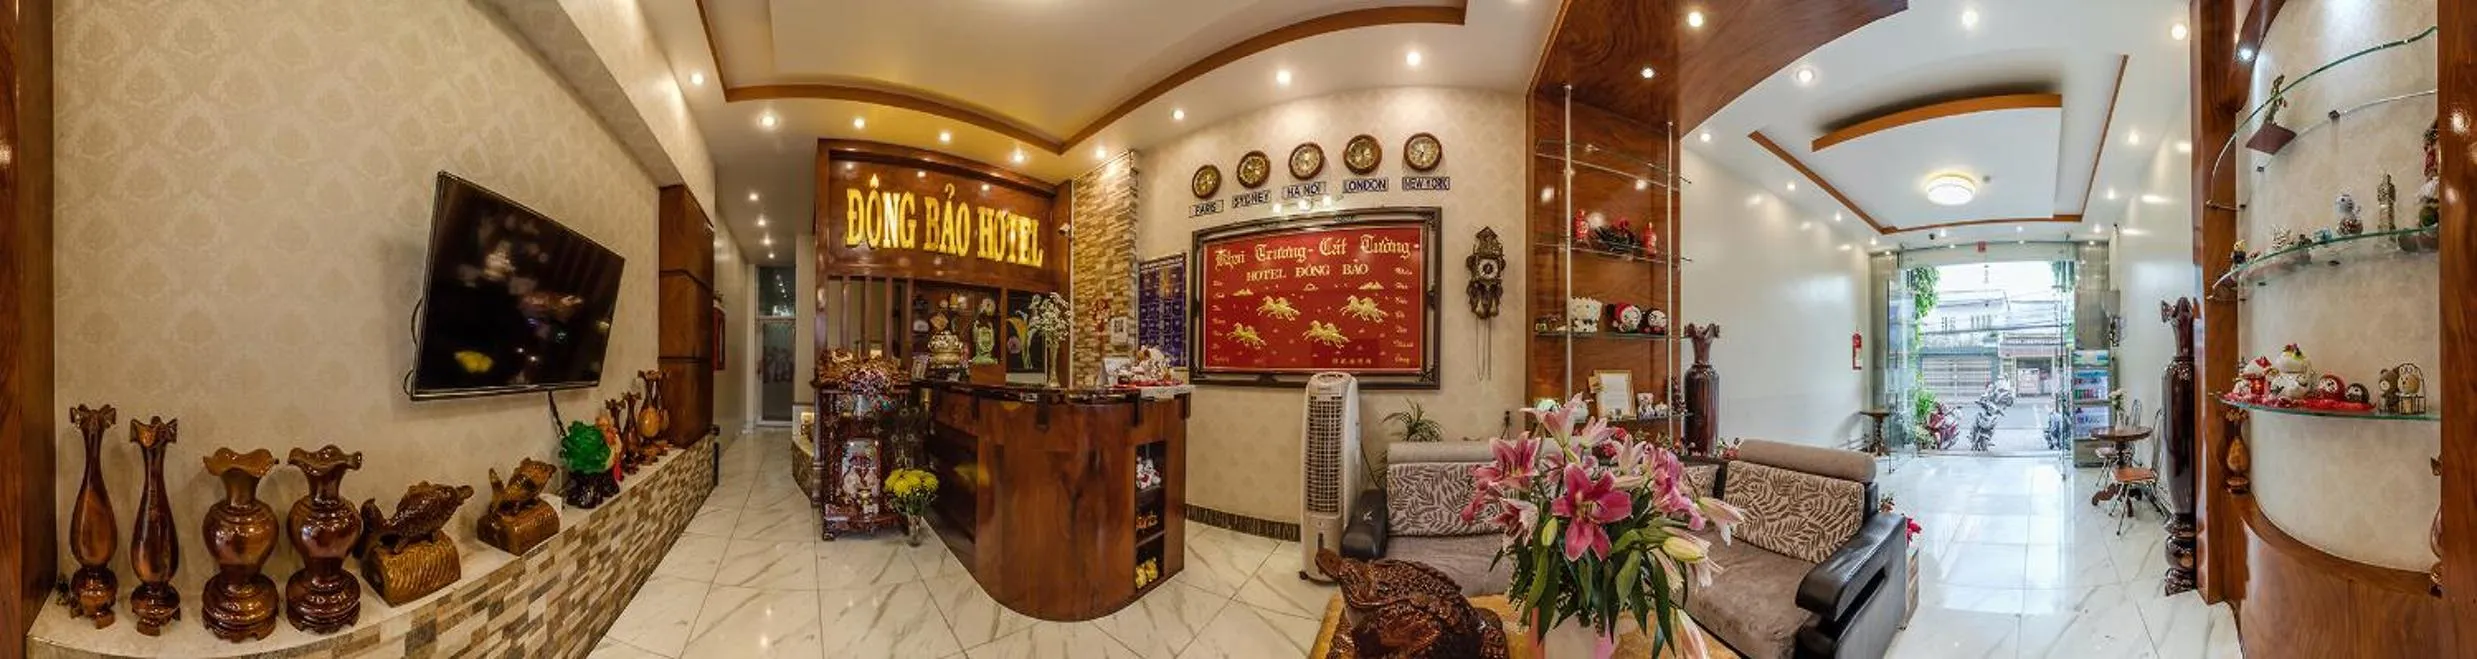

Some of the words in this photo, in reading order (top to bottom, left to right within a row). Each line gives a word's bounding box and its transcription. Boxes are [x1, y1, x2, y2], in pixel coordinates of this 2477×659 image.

[1344, 179, 1386, 192] LONDON
[1233, 192, 1269, 208] SYDNEY
[846, 173, 918, 249] ĐÔNG
[923, 183, 971, 257] BẢO
[976, 205, 1044, 268] HOTEL
[1246, 269, 1287, 281] HOTEL
